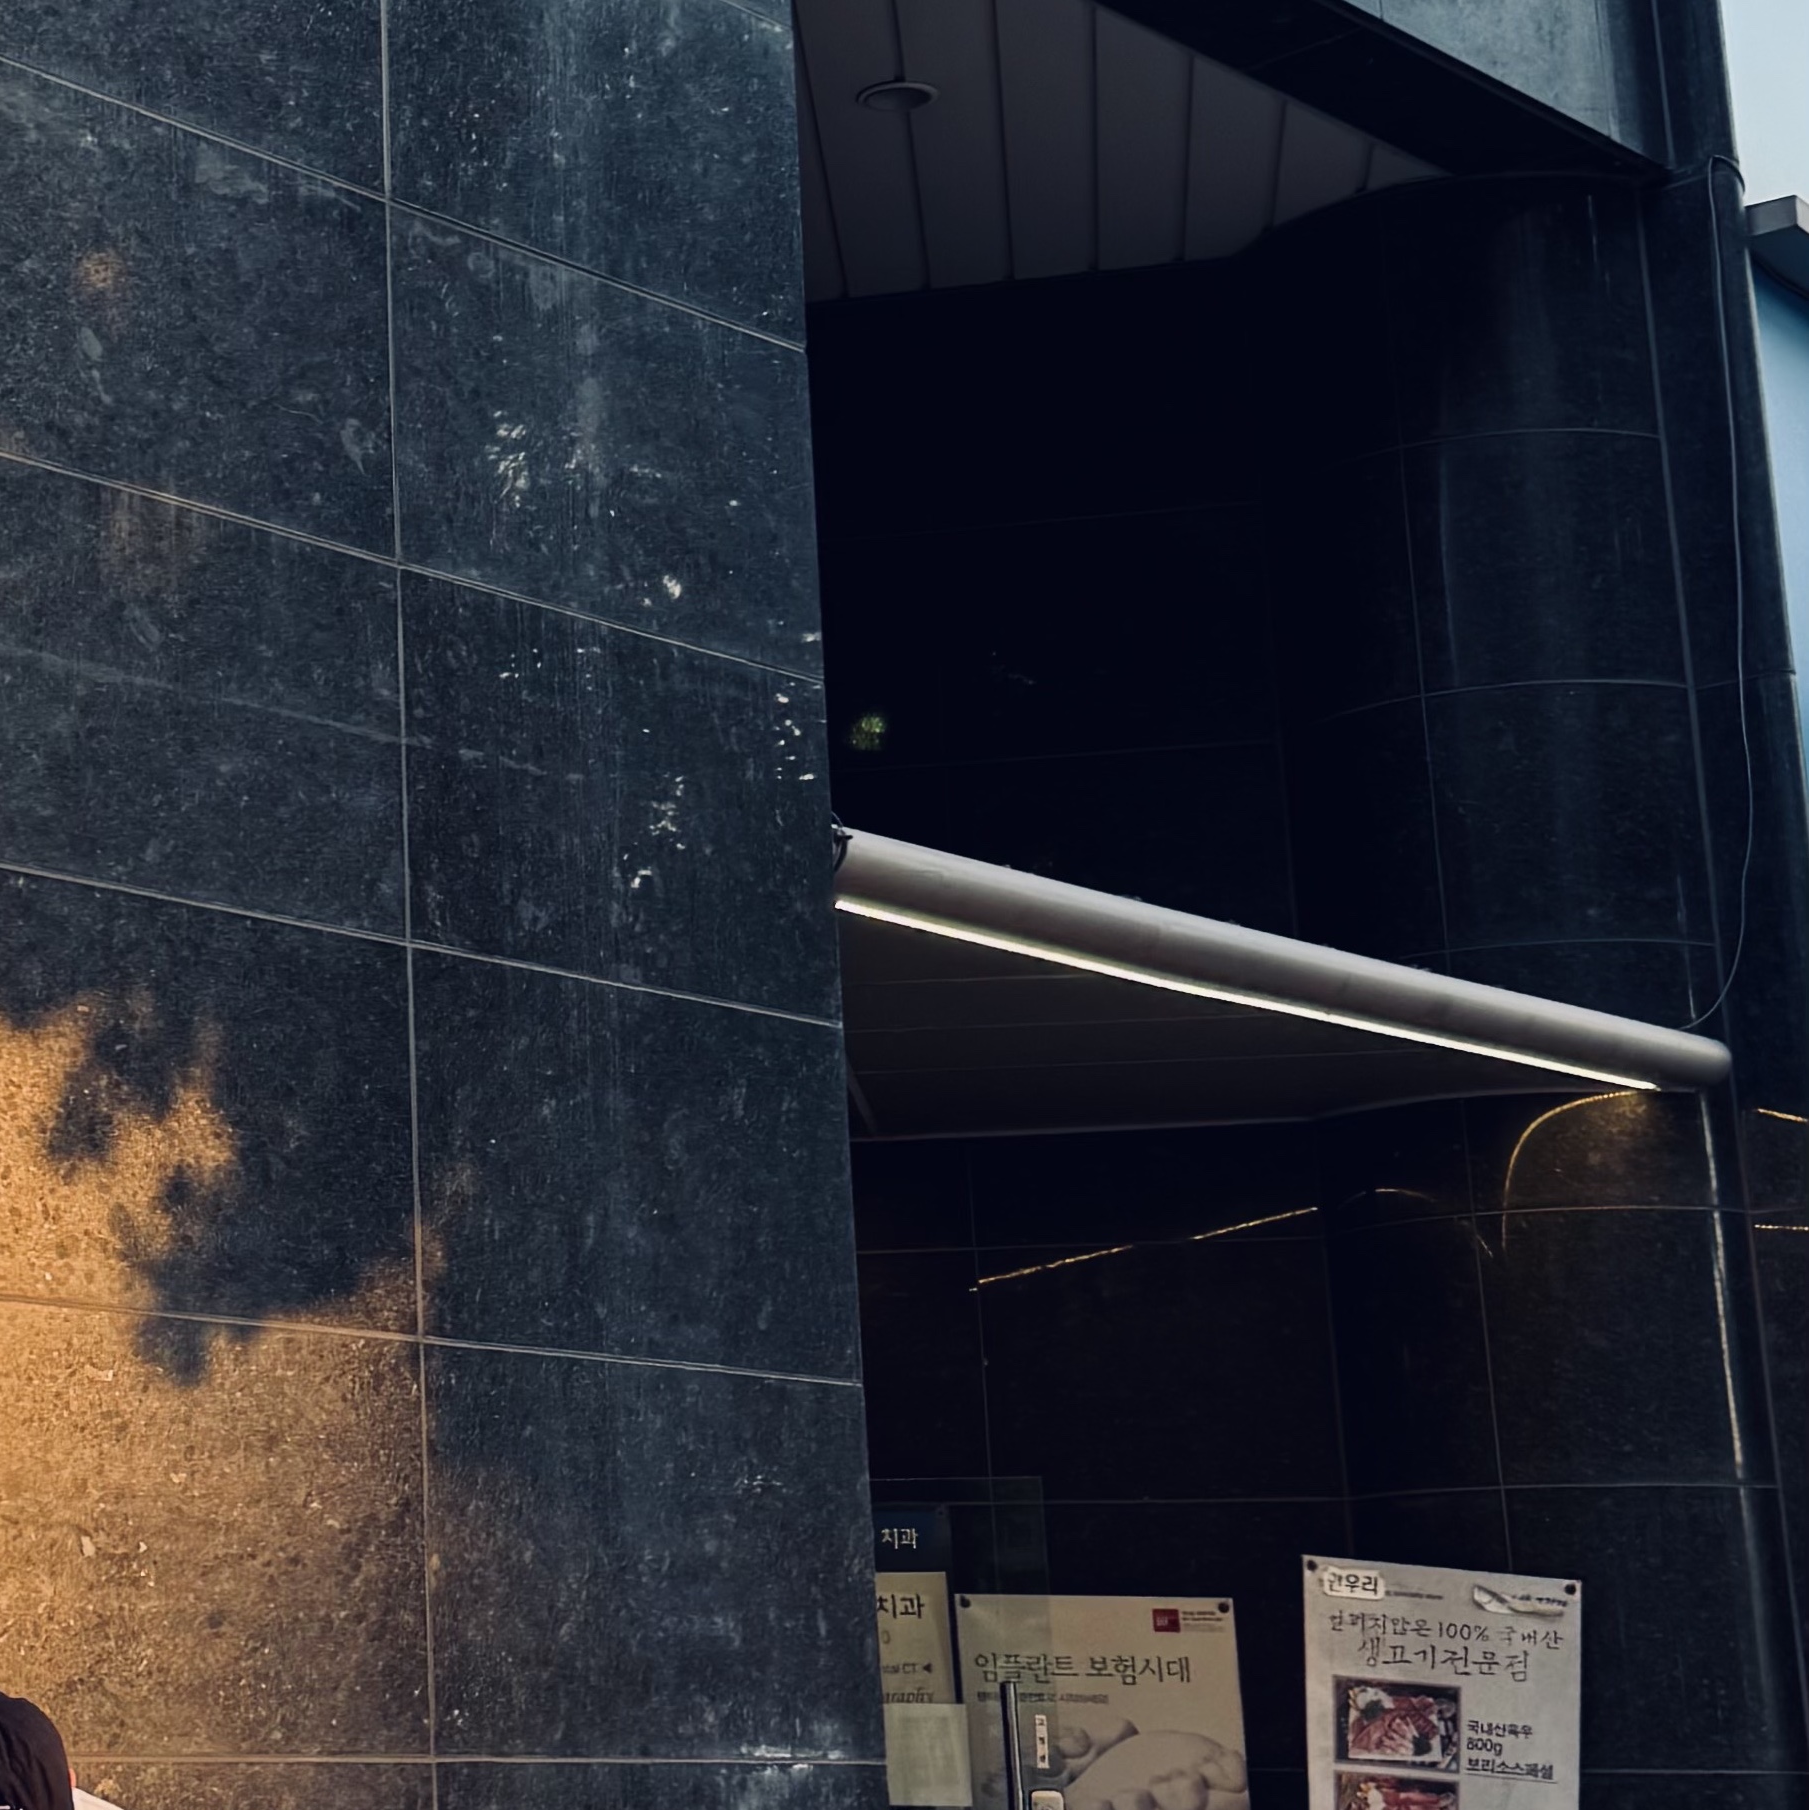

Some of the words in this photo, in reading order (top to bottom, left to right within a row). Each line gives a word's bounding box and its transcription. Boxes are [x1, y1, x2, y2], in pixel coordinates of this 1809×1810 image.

[877, 1593, 926, 1619] 치과
[1437, 1621, 1490, 1641] 100%
[974, 1652, 1079, 1684] 임플란트
[1085, 1655, 1192, 1685] 보험시대
[1357, 1635, 1530, 1682] 생고기전문점
